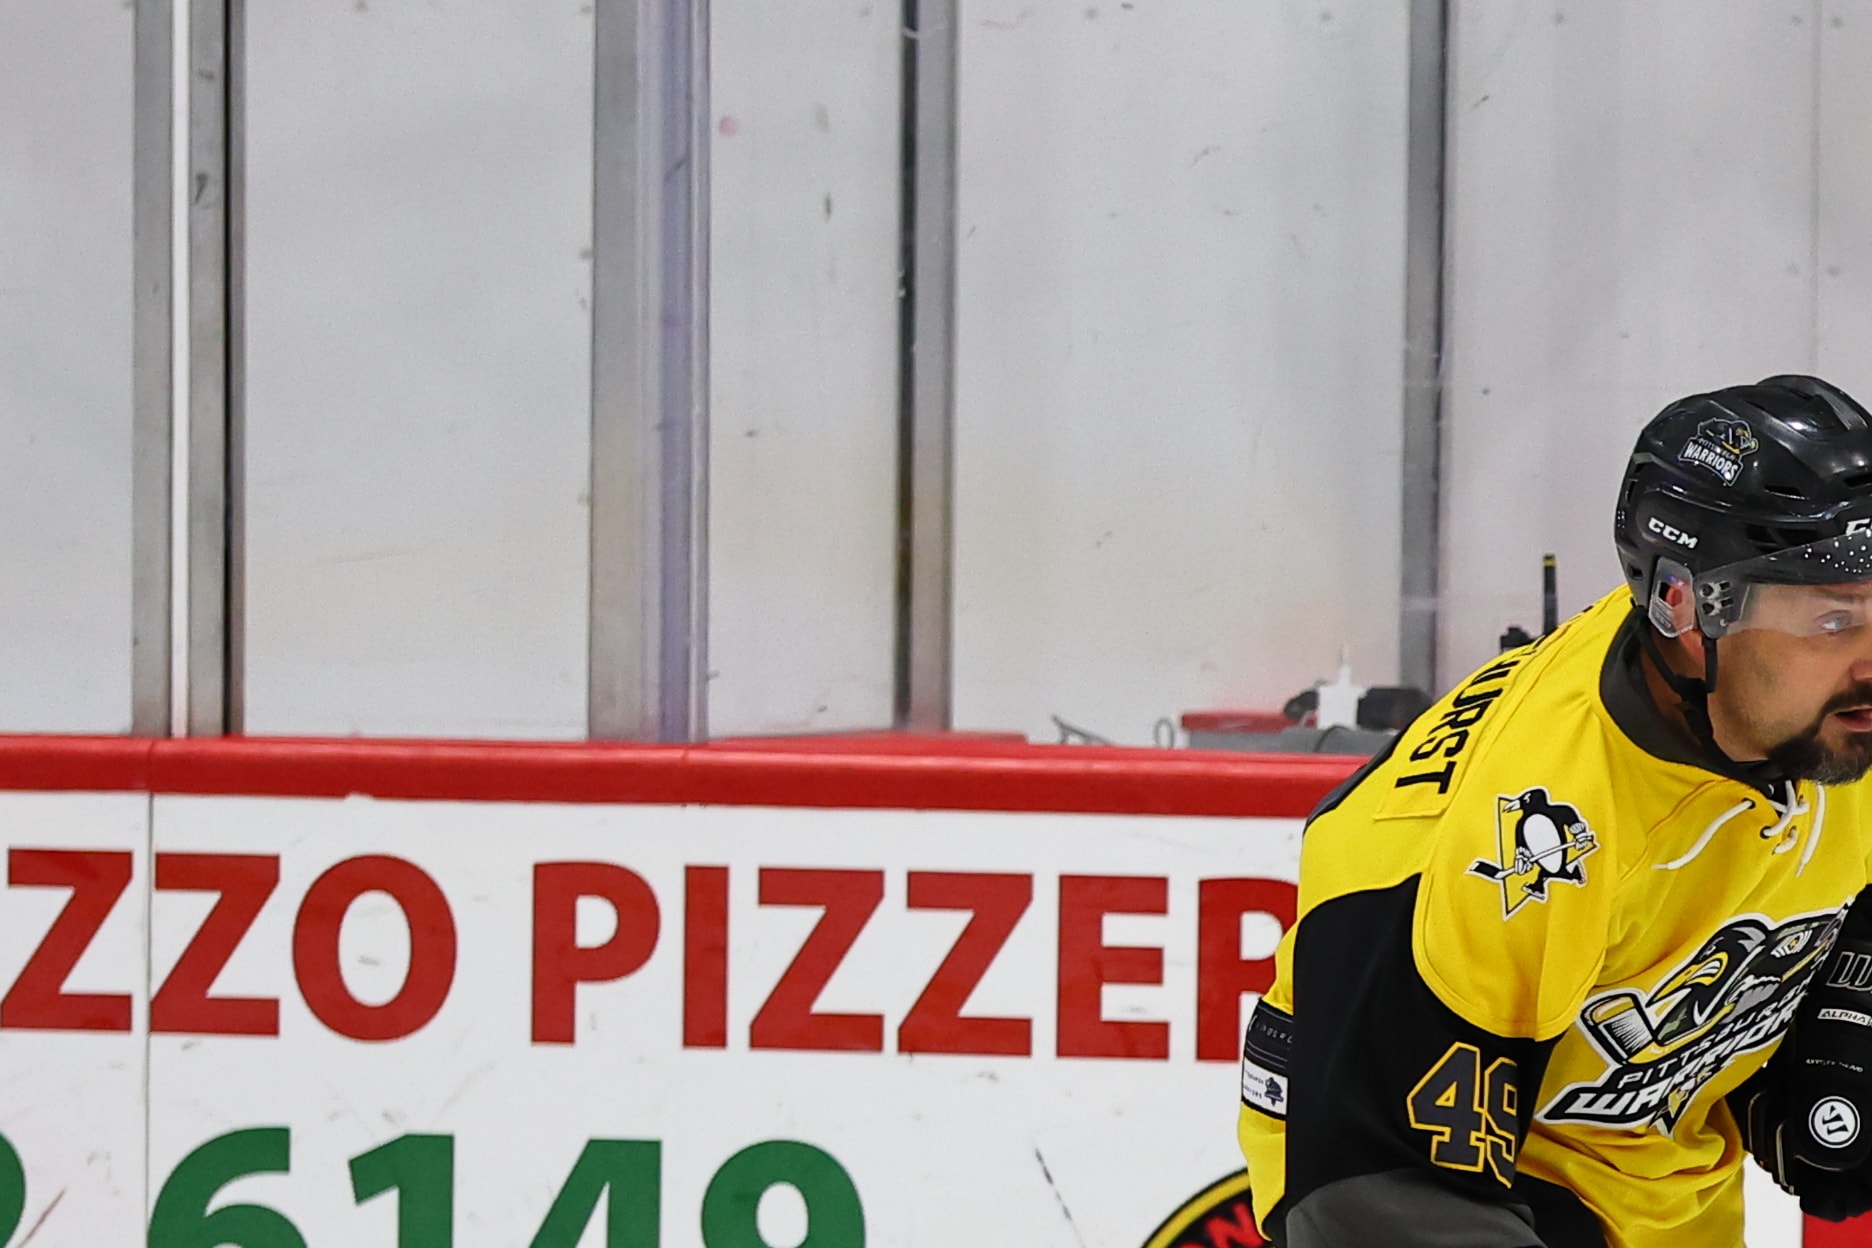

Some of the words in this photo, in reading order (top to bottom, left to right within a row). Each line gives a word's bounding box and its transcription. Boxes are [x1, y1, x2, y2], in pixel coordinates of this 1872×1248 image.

[1683, 441, 1740, 481] WARRIORS
[1648, 517, 1699, 550] CCM
[1821, 1009, 1867, 1024] ALPHA
[1406, 1041, 1518, 1189] 49
